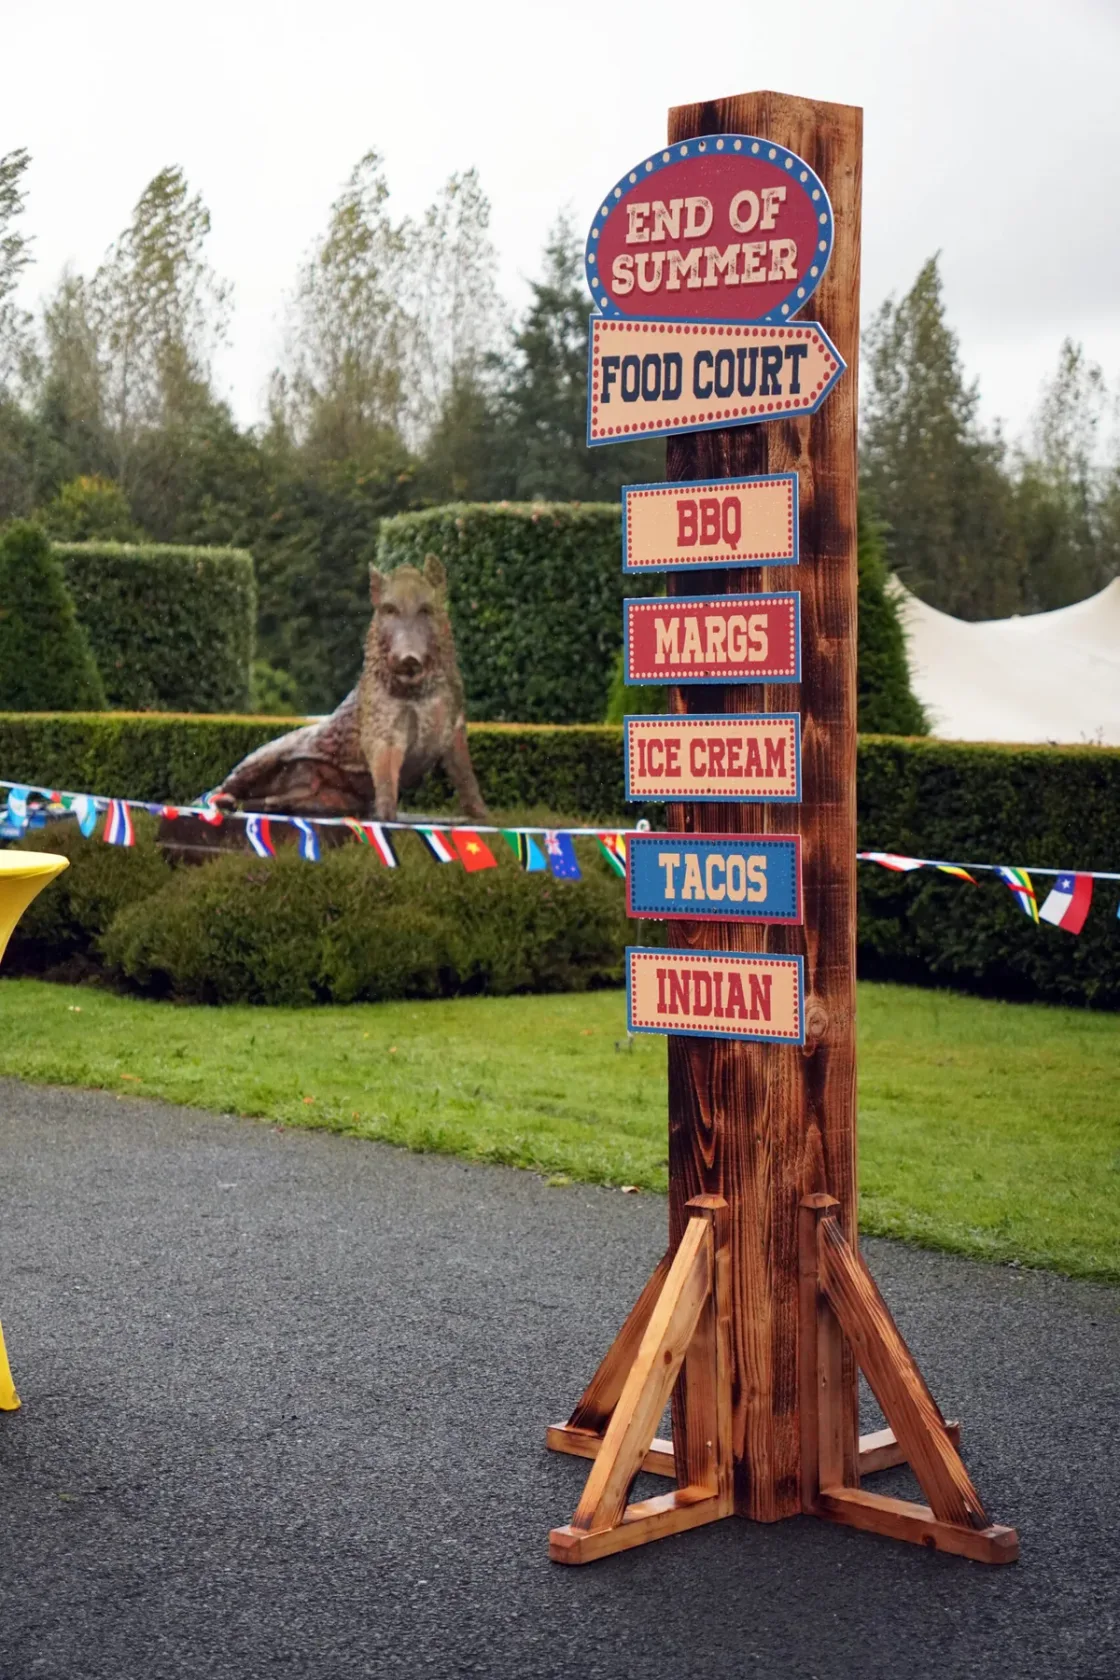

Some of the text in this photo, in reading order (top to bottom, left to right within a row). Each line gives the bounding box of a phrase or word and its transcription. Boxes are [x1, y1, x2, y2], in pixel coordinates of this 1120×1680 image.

[625, 186, 787, 244] END OF
[611, 238, 798, 295] SUMMER
[600, 343, 808, 403] FOOD COURT
[676, 496, 742, 550] BBQ
[654, 613, 769, 664] MARGS
[637, 737, 787, 778] ICE CREAM
[658, 853, 768, 902] TACOS
[656, 968, 772, 1021] INDIAN
